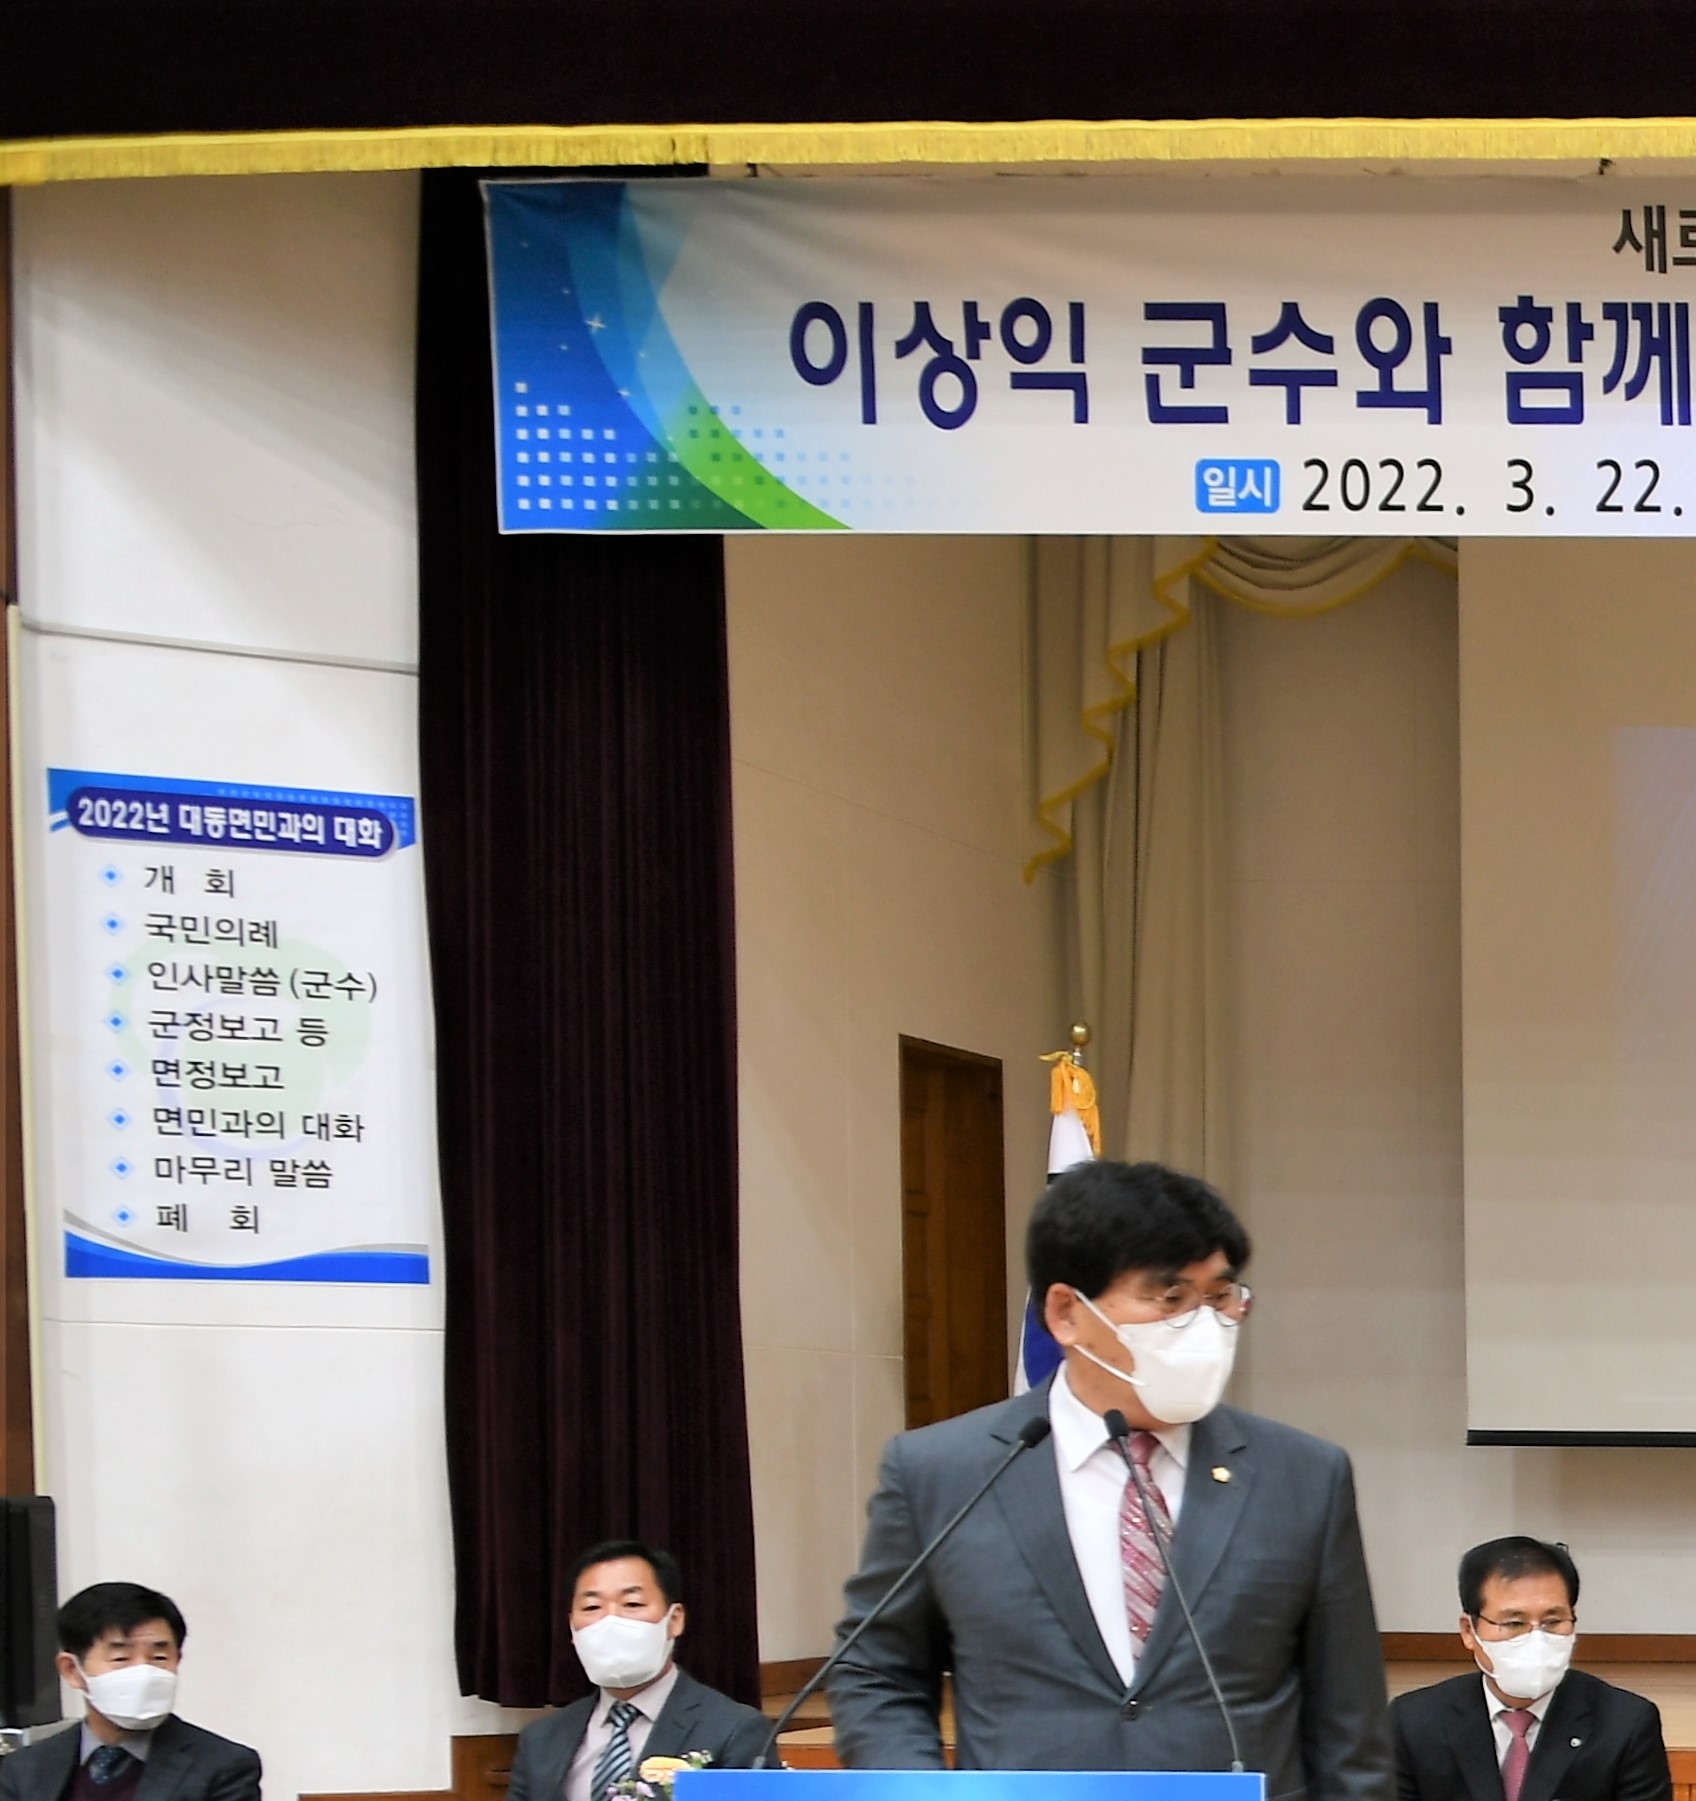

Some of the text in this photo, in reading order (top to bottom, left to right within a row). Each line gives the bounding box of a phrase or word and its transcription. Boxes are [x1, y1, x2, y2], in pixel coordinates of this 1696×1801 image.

[790, 297, 1089, 430] 이상익
[1141, 297, 1453, 425] 군수와
[1203, 466, 1272, 507] 일시
[1302, 458, 1465, 516] 2022.
[1506, 458, 1555, 516] 3.
[77, 796, 386, 850] 2022년 대동면민과의 대화
[145, 912, 279, 950] 국민의례
[147, 961, 378, 1004] 인사말씀 (군수)
[148, 1010, 330, 1048] 군정보고 등
[151, 1058, 286, 1090] 면정보고
[153, 1106, 366, 1143] 면민과의 대화
[154, 1155, 334, 1190] 마무리 말씀
